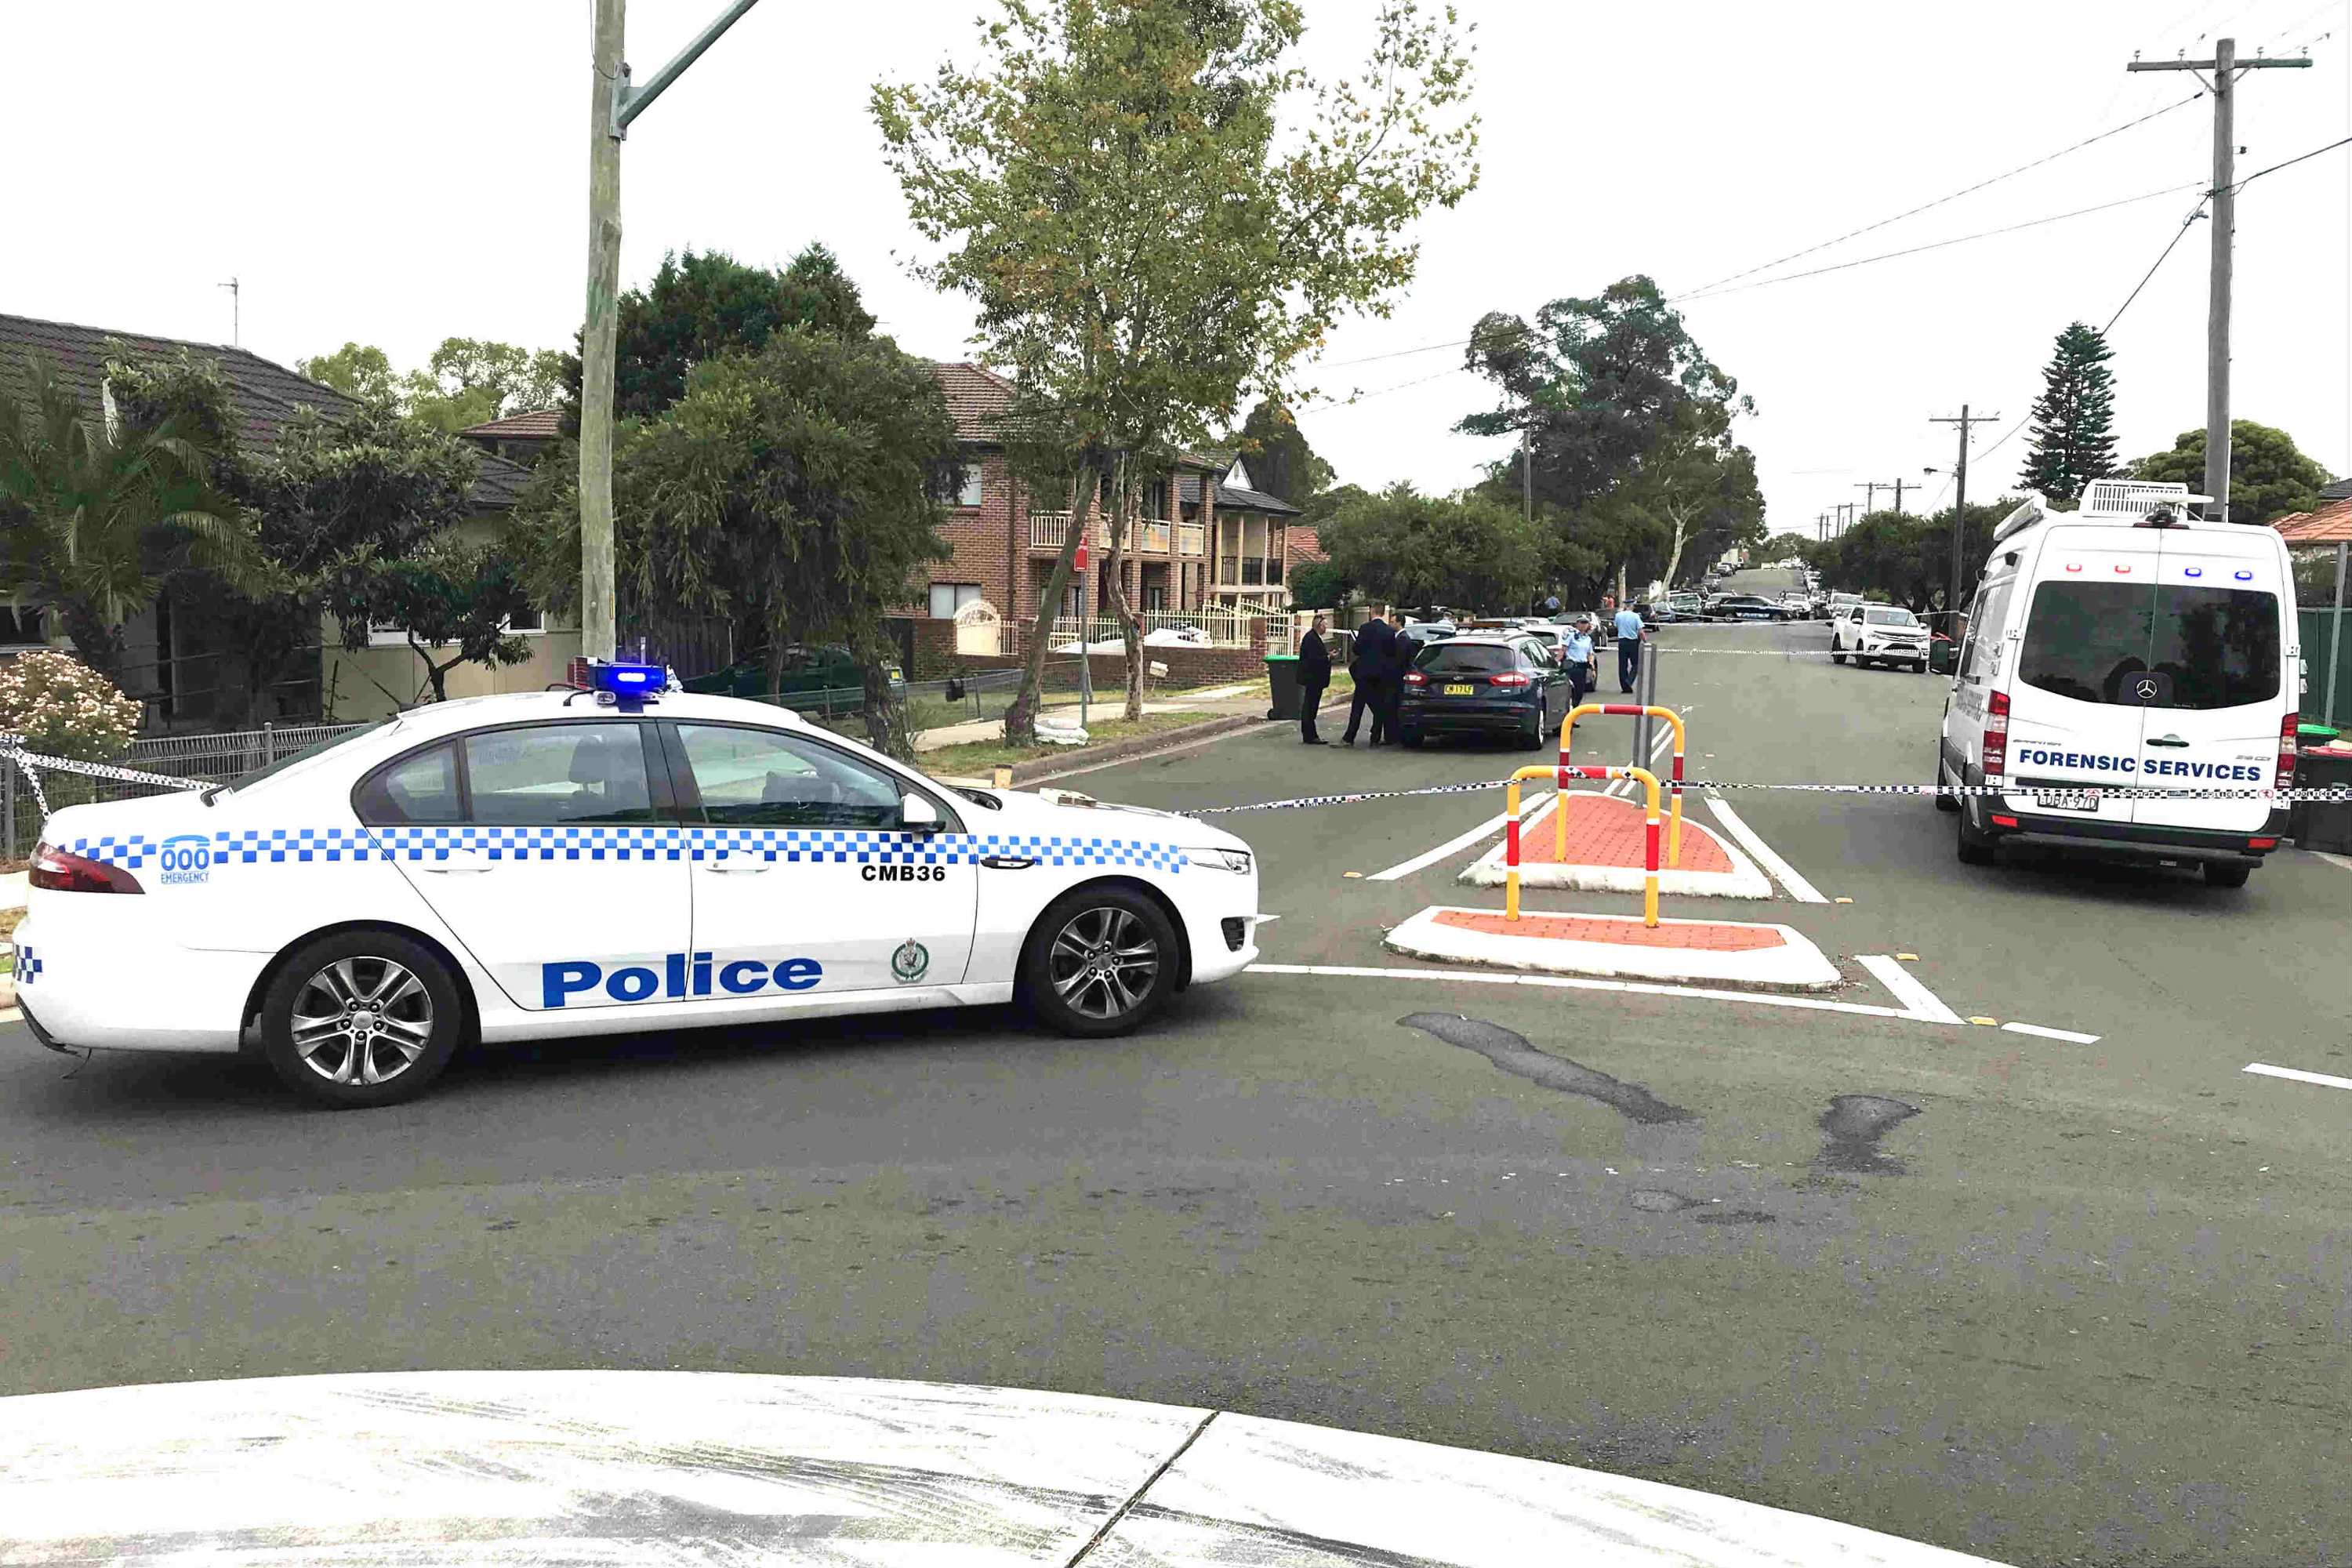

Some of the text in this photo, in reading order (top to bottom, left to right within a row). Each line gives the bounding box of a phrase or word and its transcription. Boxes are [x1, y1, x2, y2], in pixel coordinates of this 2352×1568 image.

[2020, 750, 2261, 781] FORENSIC SERVICES
[161, 848, 209, 871] 000
[161, 871, 209, 884] EMERGENCY
[862, 865, 946, 881] CMB36
[542, 951, 823, 1008] Police
